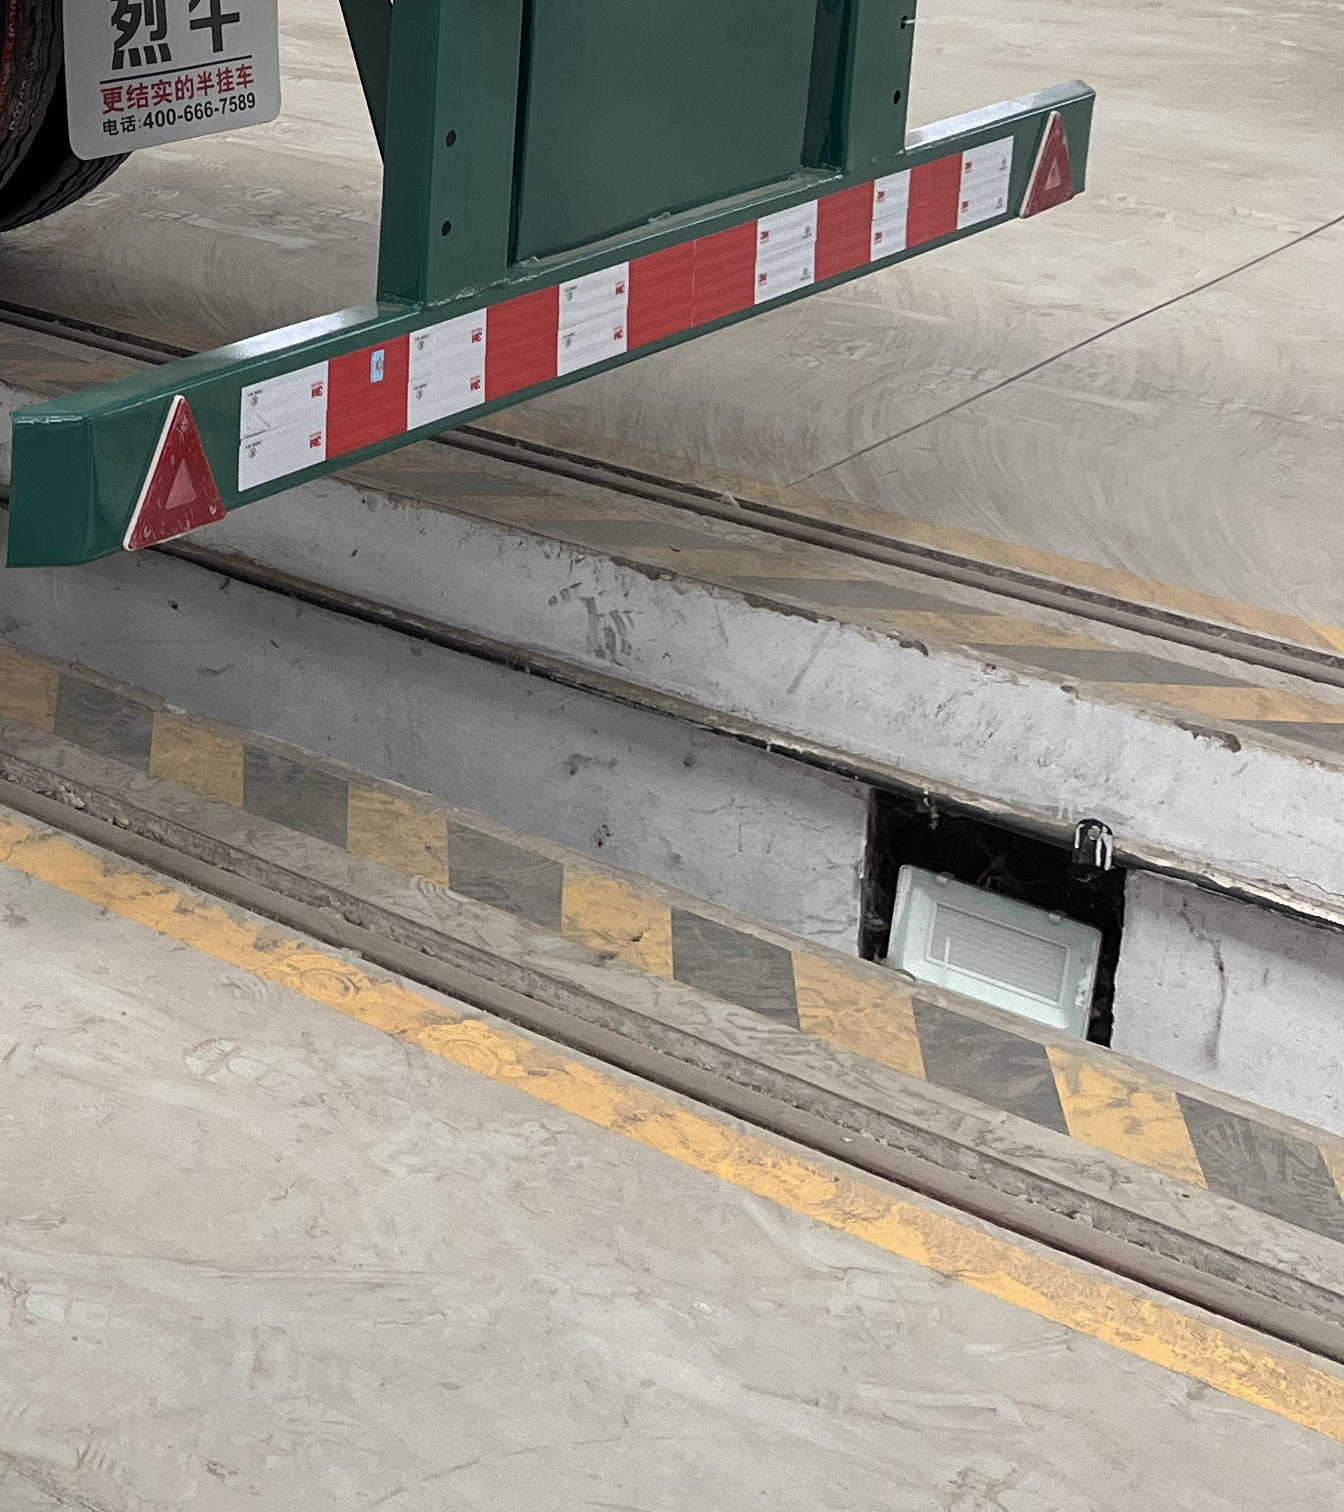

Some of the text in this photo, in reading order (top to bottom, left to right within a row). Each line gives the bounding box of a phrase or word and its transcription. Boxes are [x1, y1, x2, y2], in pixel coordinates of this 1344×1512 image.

[100, 63, 255, 115] 更结实的半挂车
